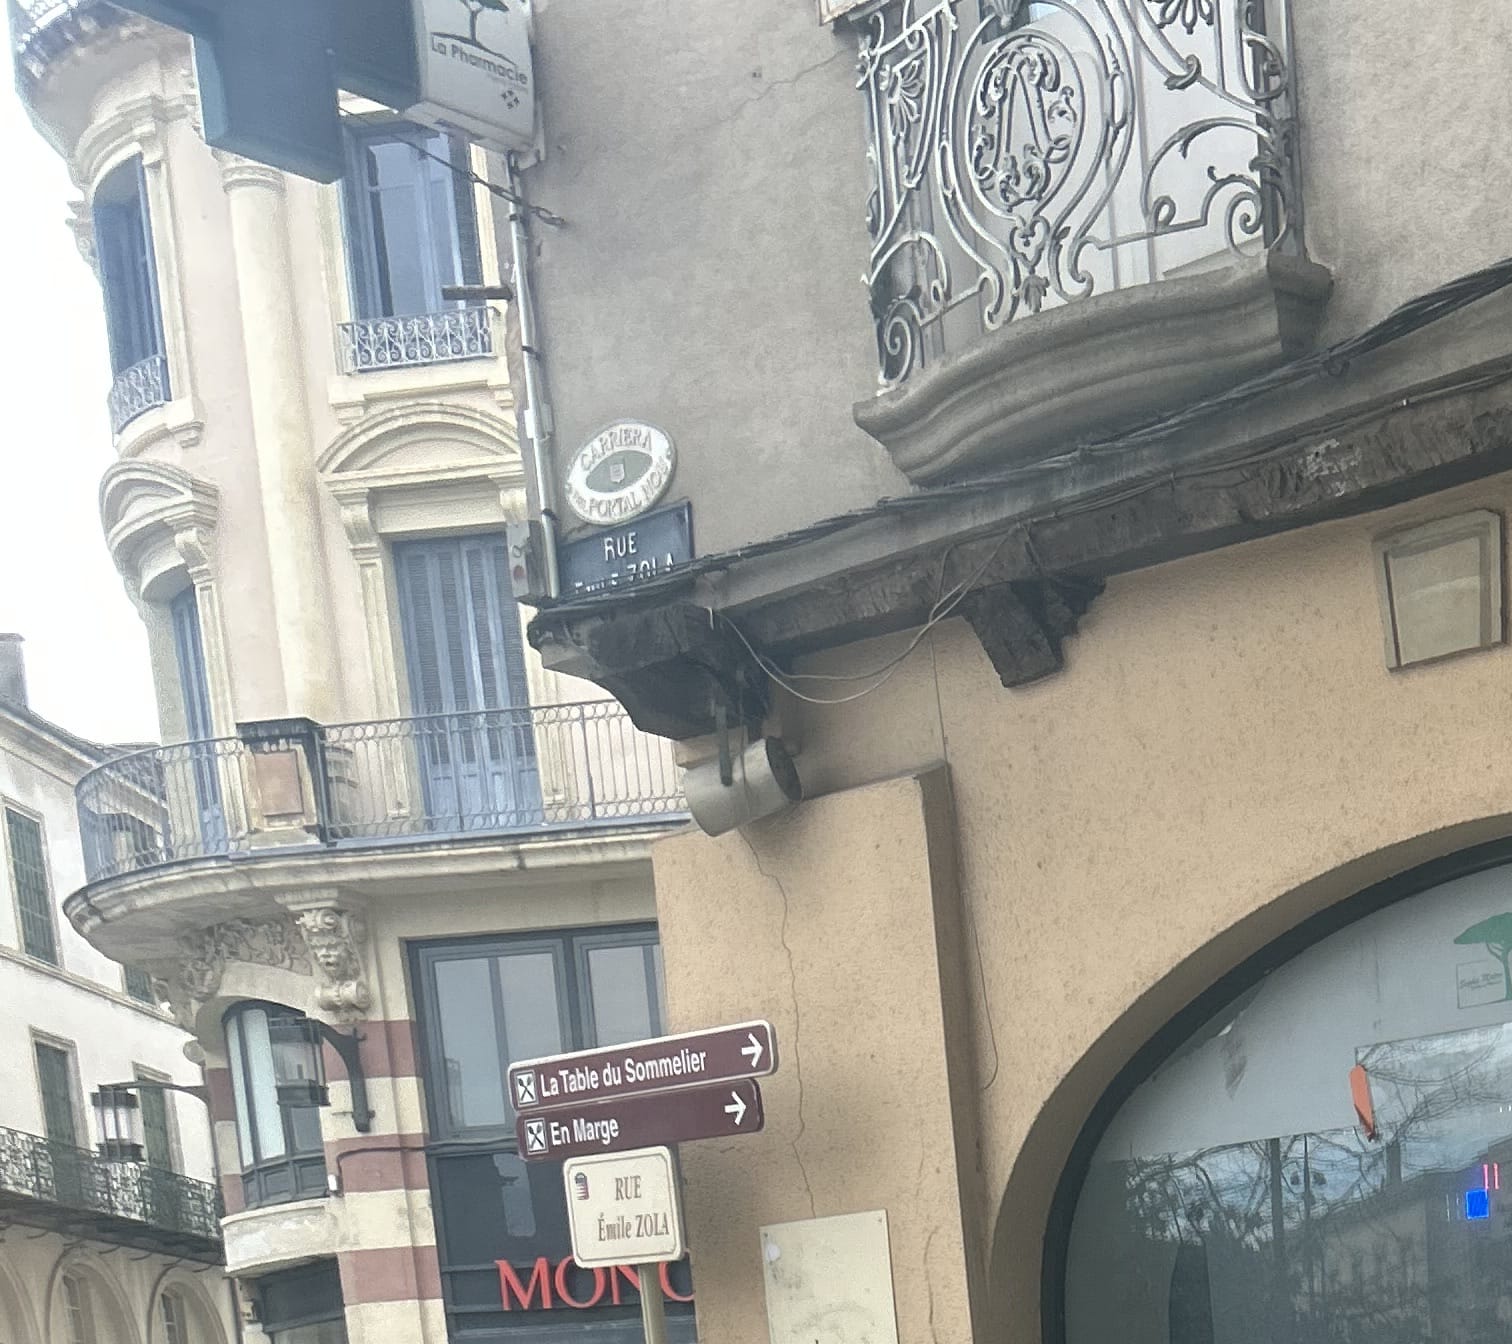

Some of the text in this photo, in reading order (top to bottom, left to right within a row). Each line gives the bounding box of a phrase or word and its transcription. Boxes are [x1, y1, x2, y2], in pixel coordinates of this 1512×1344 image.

[431, 36, 447, 56] La
[451, 44, 528, 85] Pharmacie
[604, 532, 637, 561] RUE
[541, 1048, 707, 1098] La Table du Sommelier
[550, 1117, 620, 1146] En Marge
[615, 1176, 642, 1201] RUE
[597, 1212, 670, 1242] Émile ZOLA
